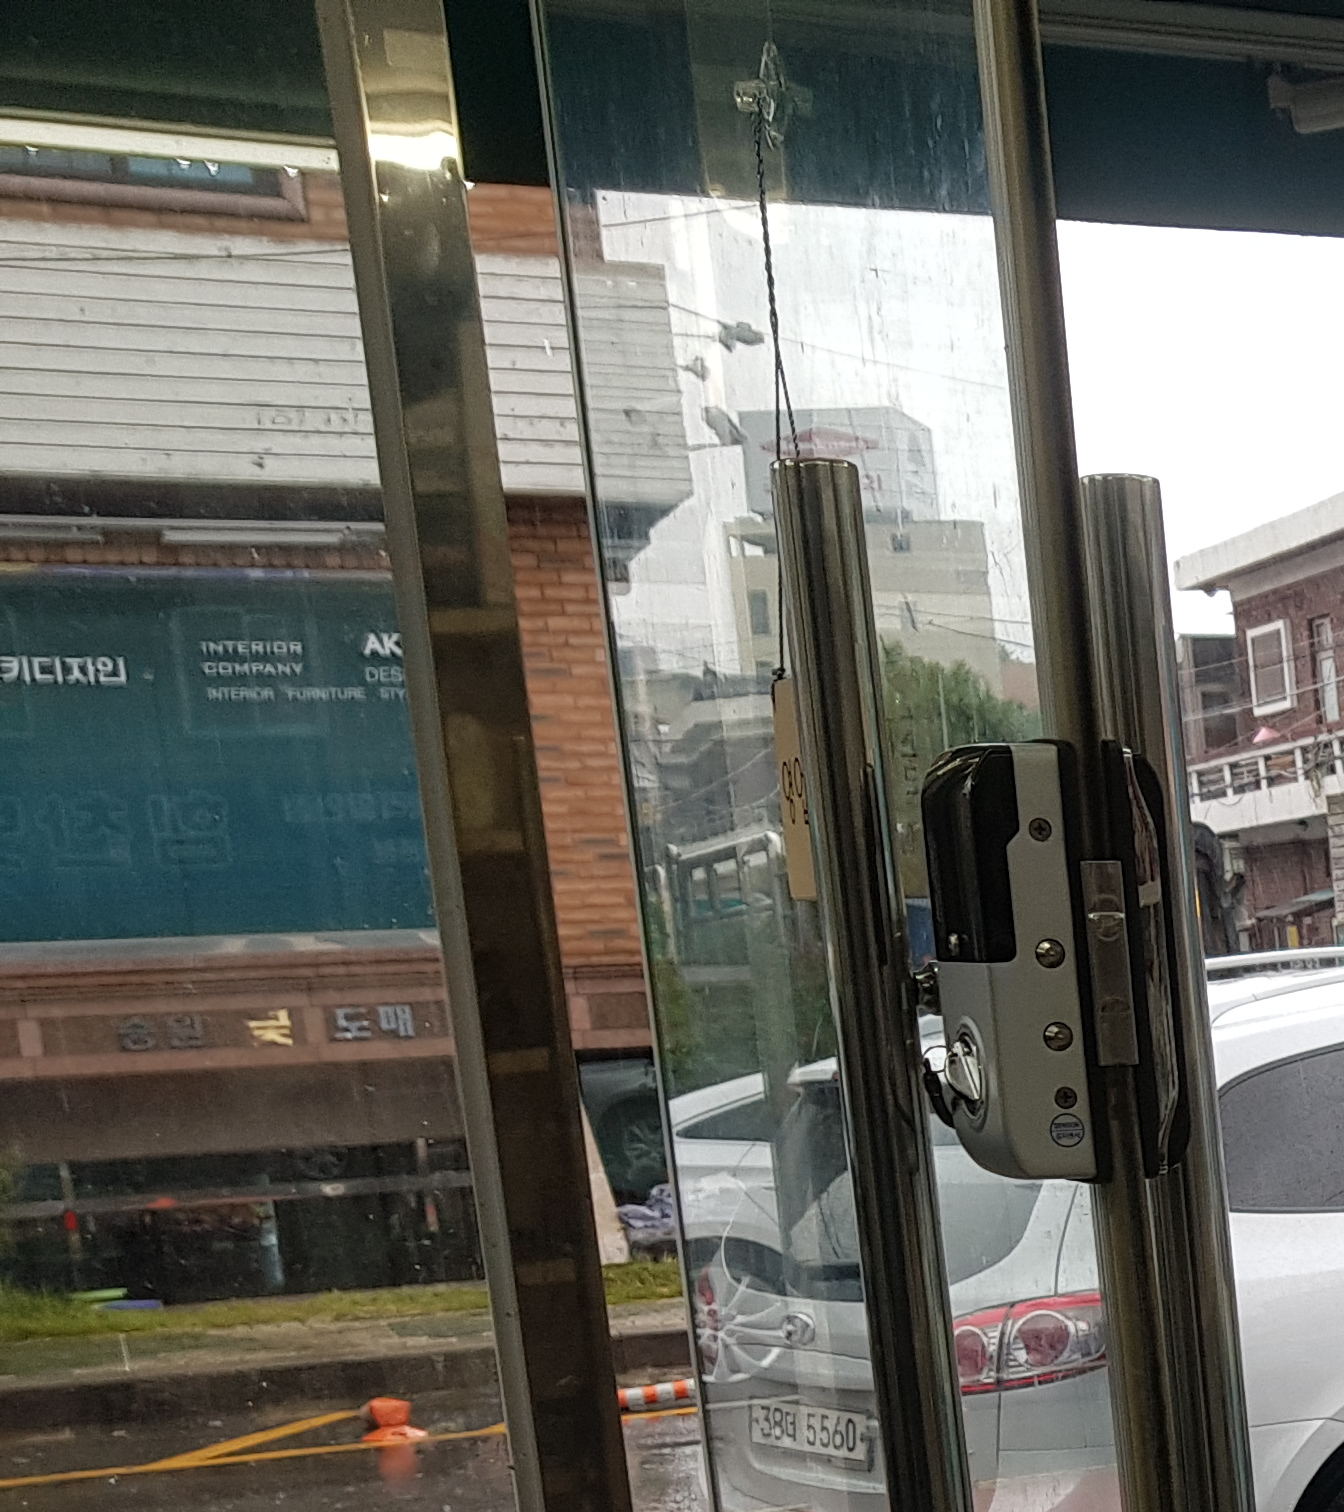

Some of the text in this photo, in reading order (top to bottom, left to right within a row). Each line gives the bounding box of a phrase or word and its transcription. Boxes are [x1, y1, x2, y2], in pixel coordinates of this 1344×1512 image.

[200, 640, 303, 656] INTERIOR
[201, 660, 304, 676] COMPANY
[365, 665, 405, 683] DES
[806, 1412, 857, 1453] 5560
